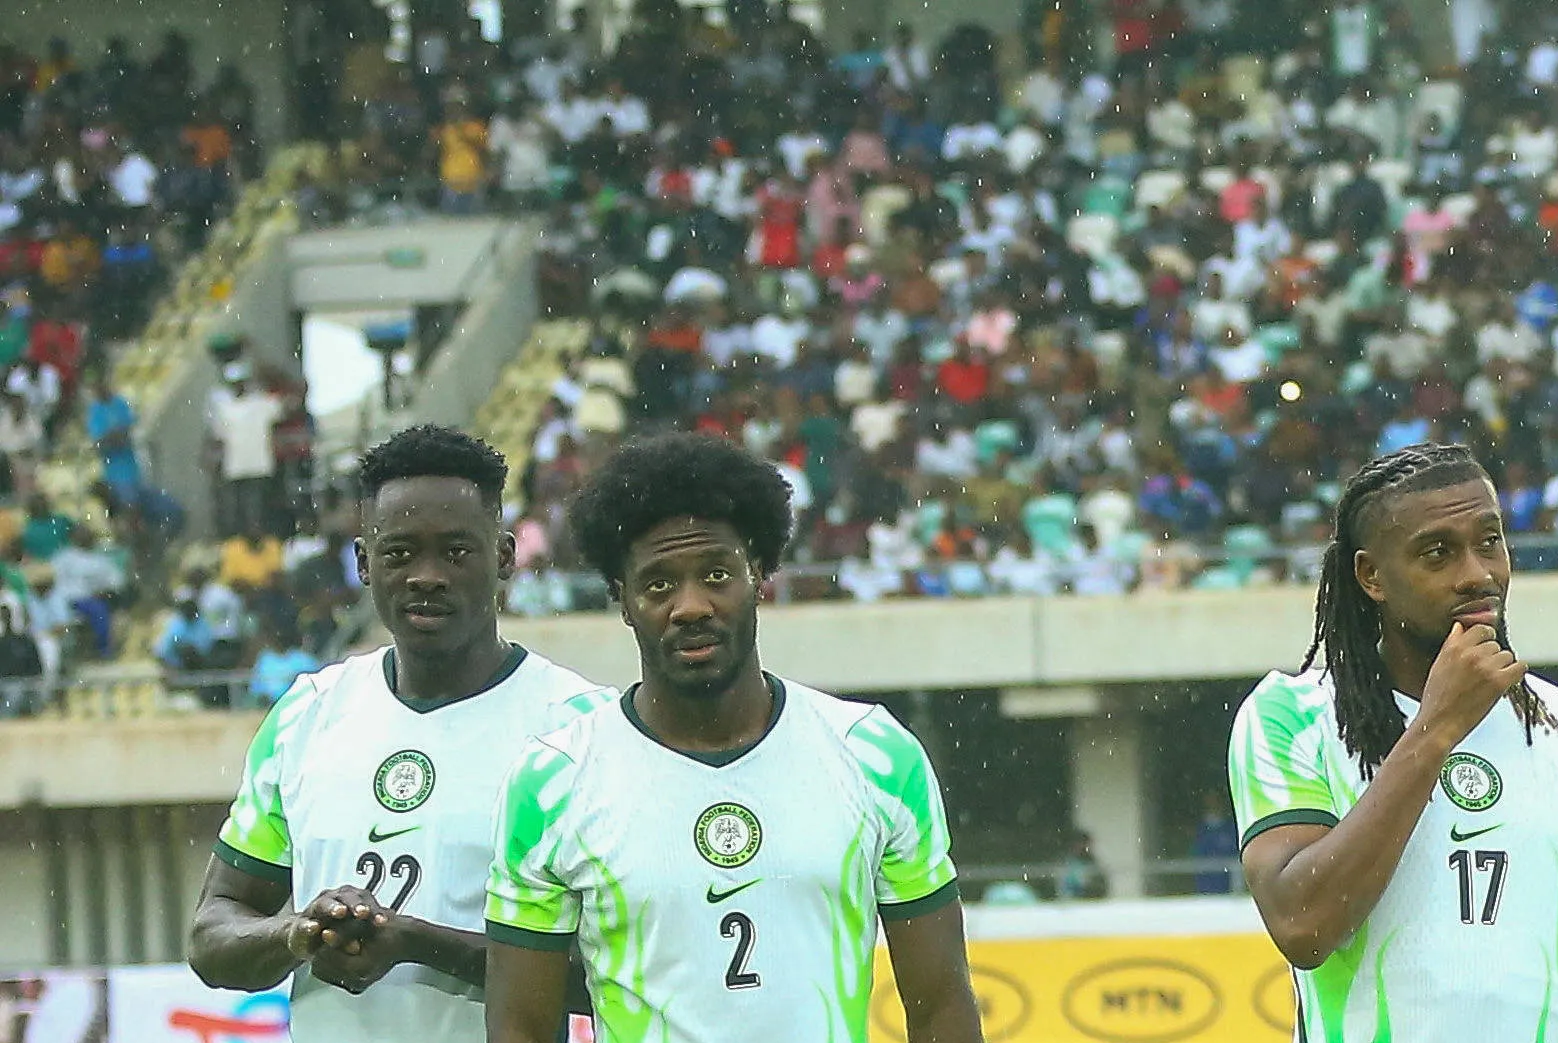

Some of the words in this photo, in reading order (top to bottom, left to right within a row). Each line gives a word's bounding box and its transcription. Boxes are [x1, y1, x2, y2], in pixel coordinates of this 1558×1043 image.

[356, 851, 422, 914] 22
[1448, 849, 1508, 925] 17
[719, 911, 761, 990] 2
[1101, 987, 1184, 1013] MTN
